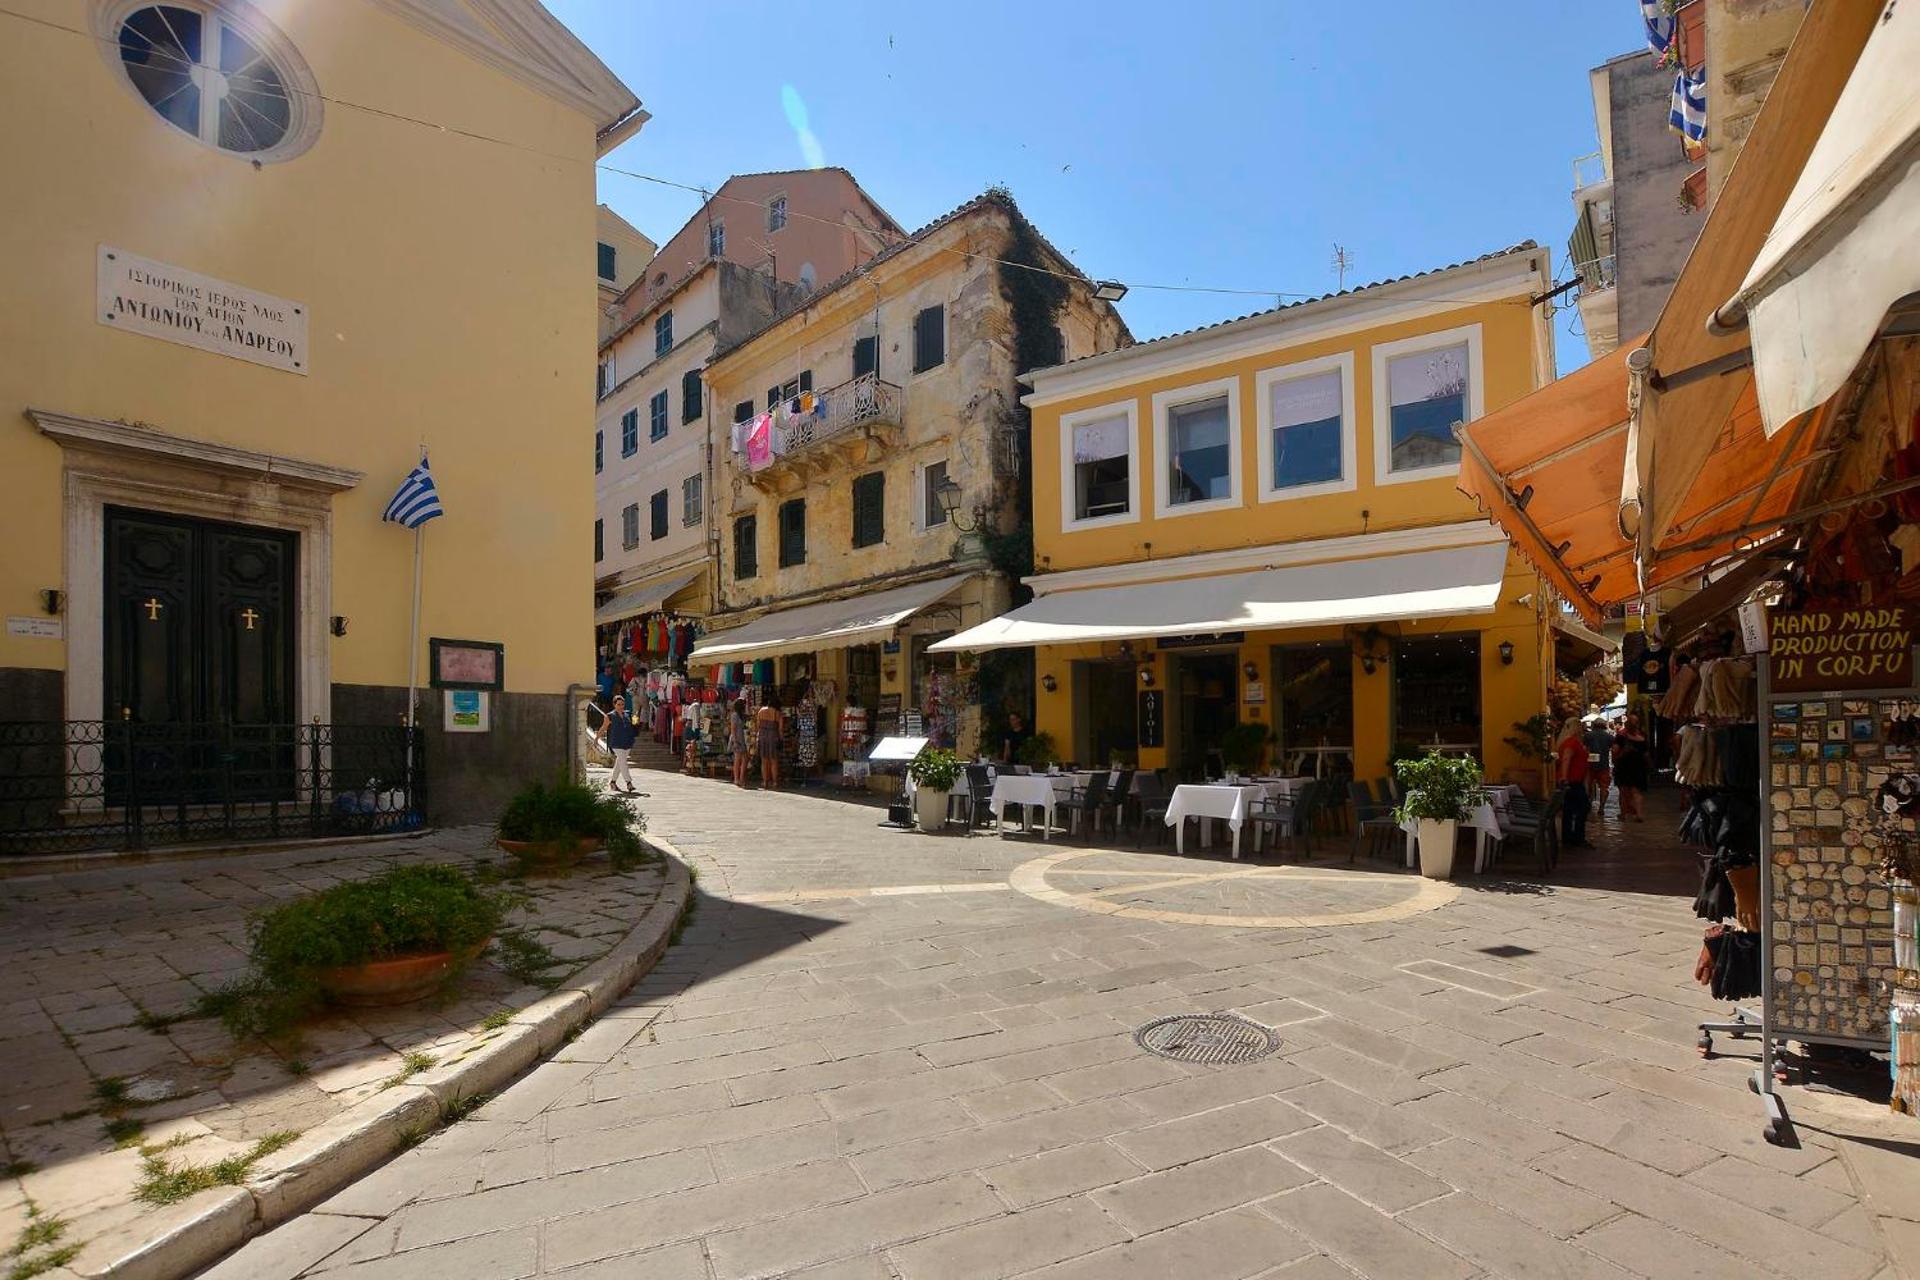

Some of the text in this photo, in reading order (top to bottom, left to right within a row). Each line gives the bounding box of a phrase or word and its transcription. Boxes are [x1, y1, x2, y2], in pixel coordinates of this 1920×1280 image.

[128, 268, 284, 323] ΙΣΤΟΡΙΚΟΣ ΙΕΡΟΣ ΝΑΟΣ
[112, 295, 204, 333] ΑΝΤΩΝΙΟΥ
[222, 325, 296, 357] ΑΝΔΡΕΟΥ
[206, 305, 244, 326] ΑΓΙΩΝ
[1772, 613, 1832, 636] HAND
[1838, 608, 1905, 631] MADE
[1770, 630, 1912, 657] PRODUCTION
[1777, 652, 1905, 680] IN CORFU
